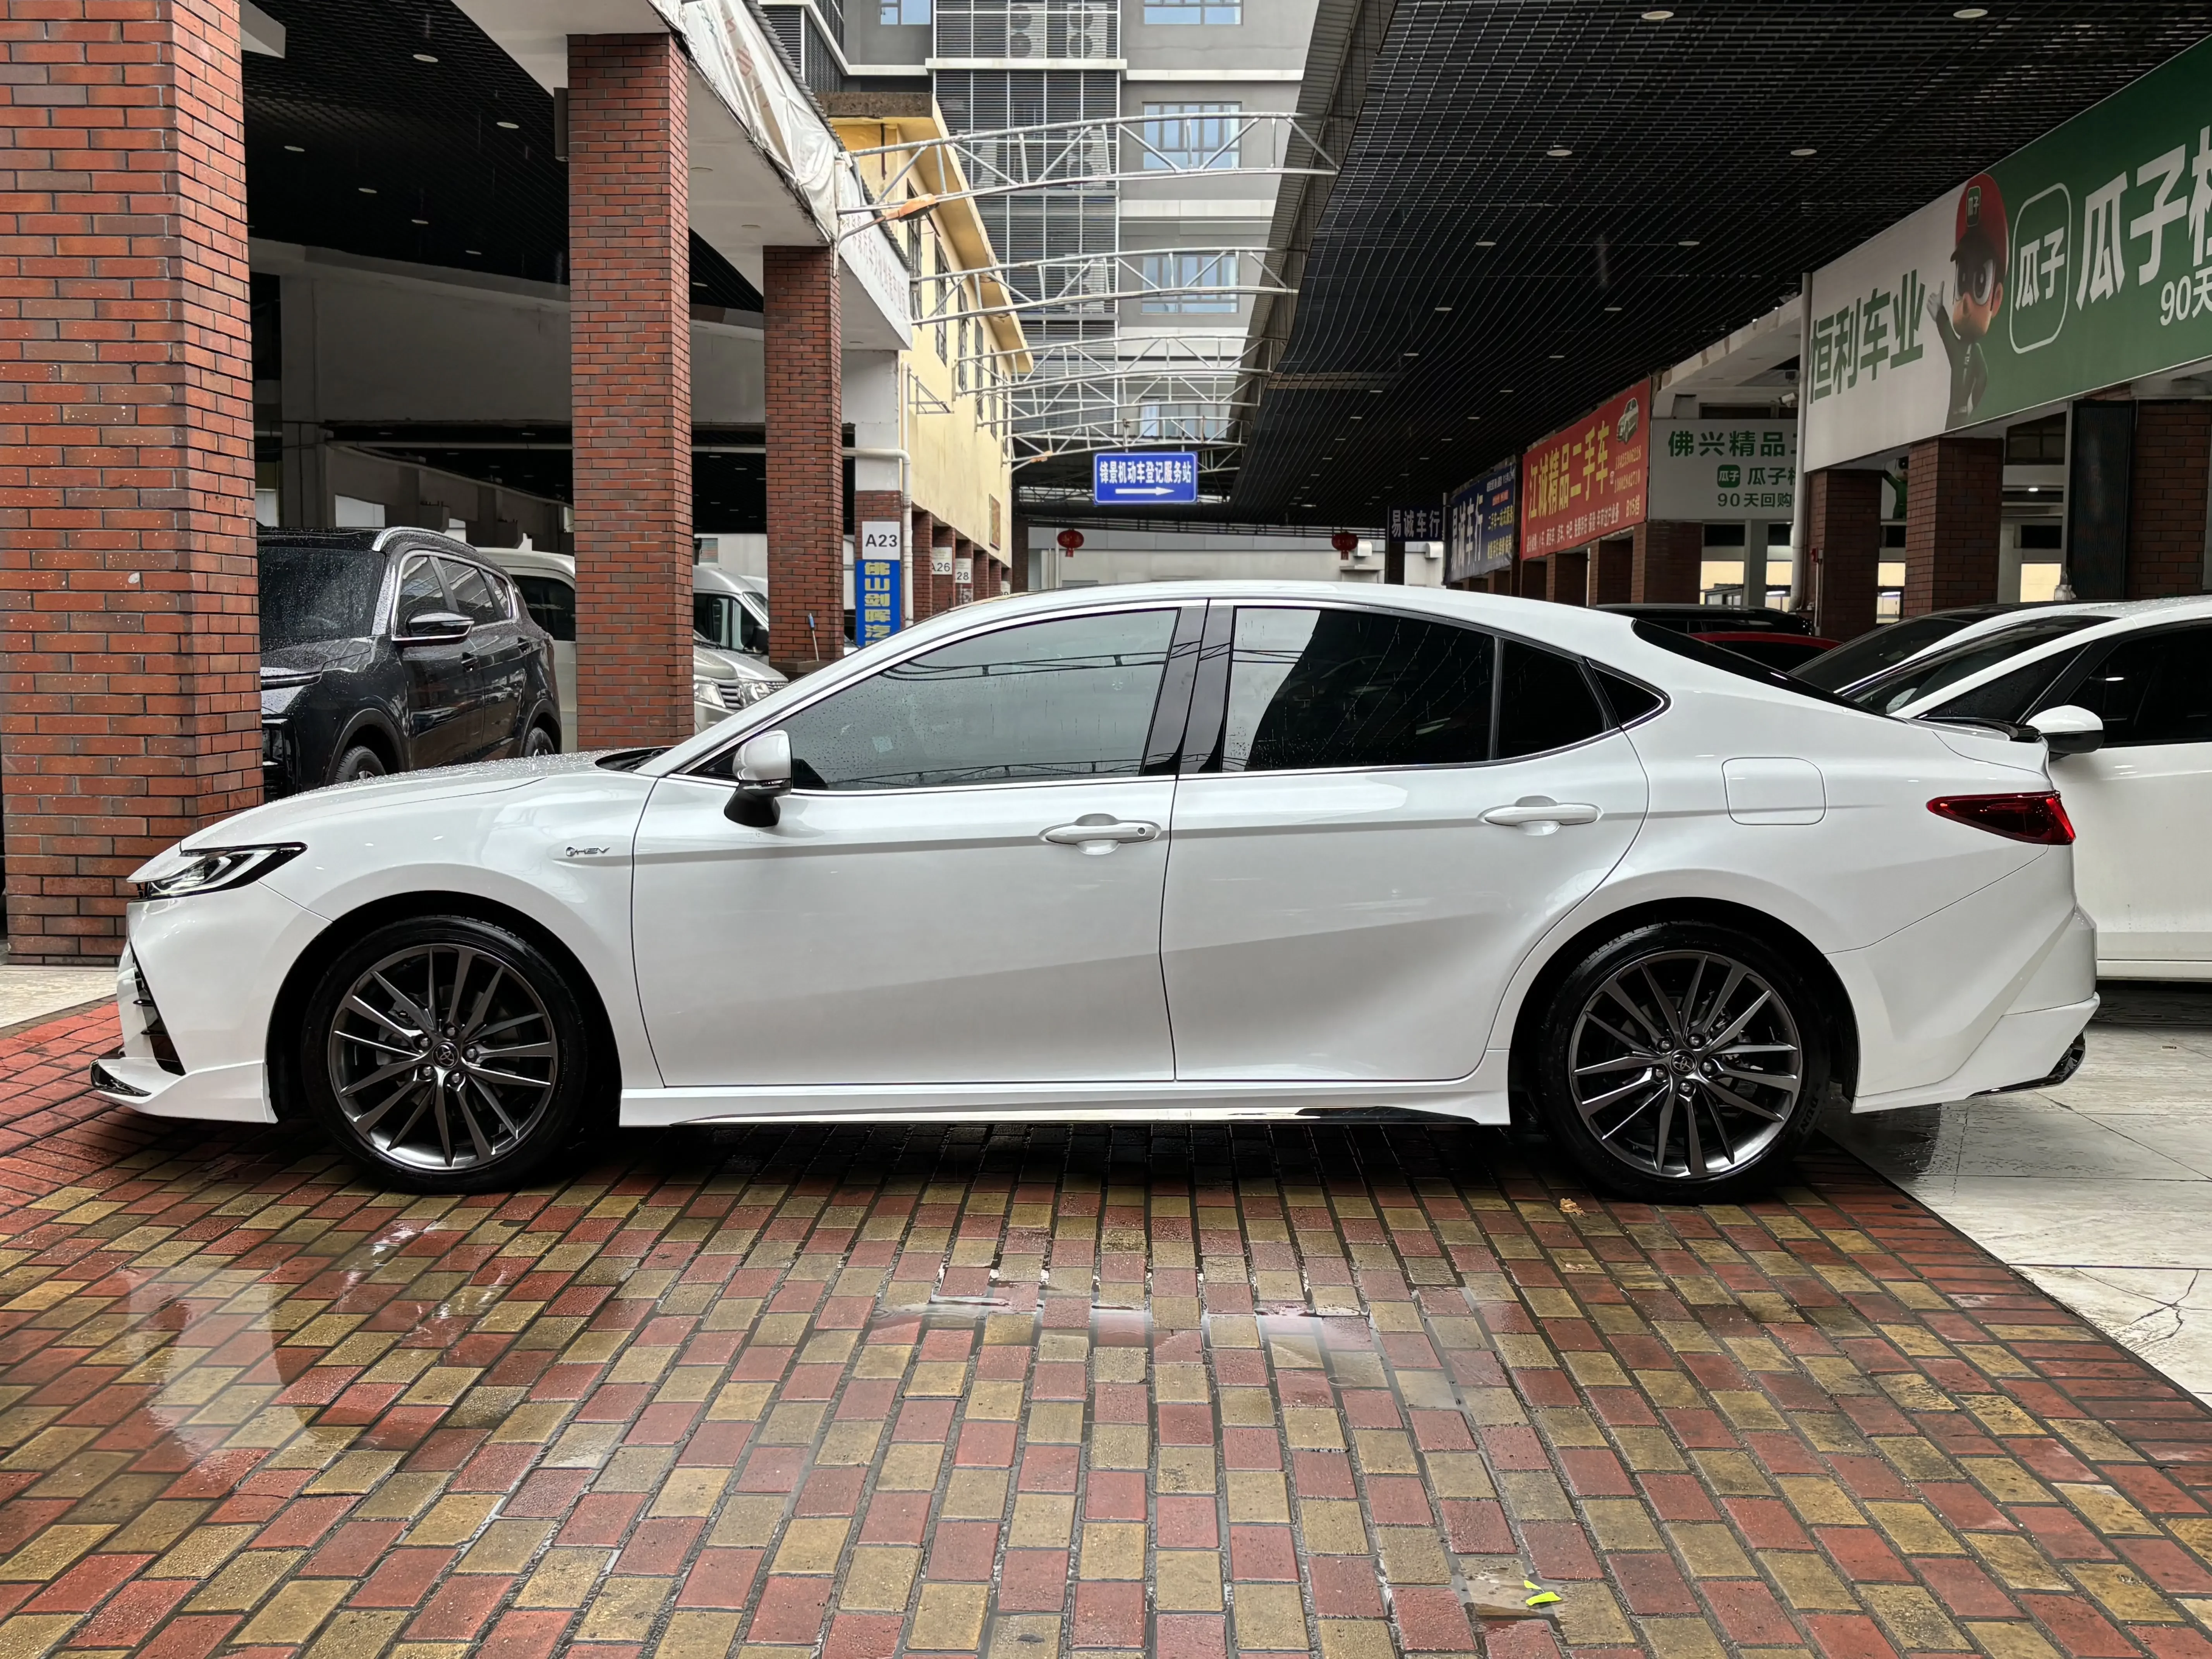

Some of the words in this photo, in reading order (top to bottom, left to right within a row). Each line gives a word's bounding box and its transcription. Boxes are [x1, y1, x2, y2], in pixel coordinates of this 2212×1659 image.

[2015, 227, 2065, 311] 瓜子
[1809, 269, 1926, 404] 恒利车业
[1668, 430, 1797, 457] 佛兴精品
[1099, 460, 1192, 484] 锋景机动车登记服务站
[1528, 420, 1609, 521] 江诚精品二手车
[1718, 471, 1740, 482] 瓜子
[1717, 492, 1795, 508] 90天回购
[1391, 509, 1441, 538] 易诚车行
[1451, 493, 1484, 572] 易诚车行
[865, 534, 898, 548] A23
[864, 562, 891, 646] 佛山剑晖汽
